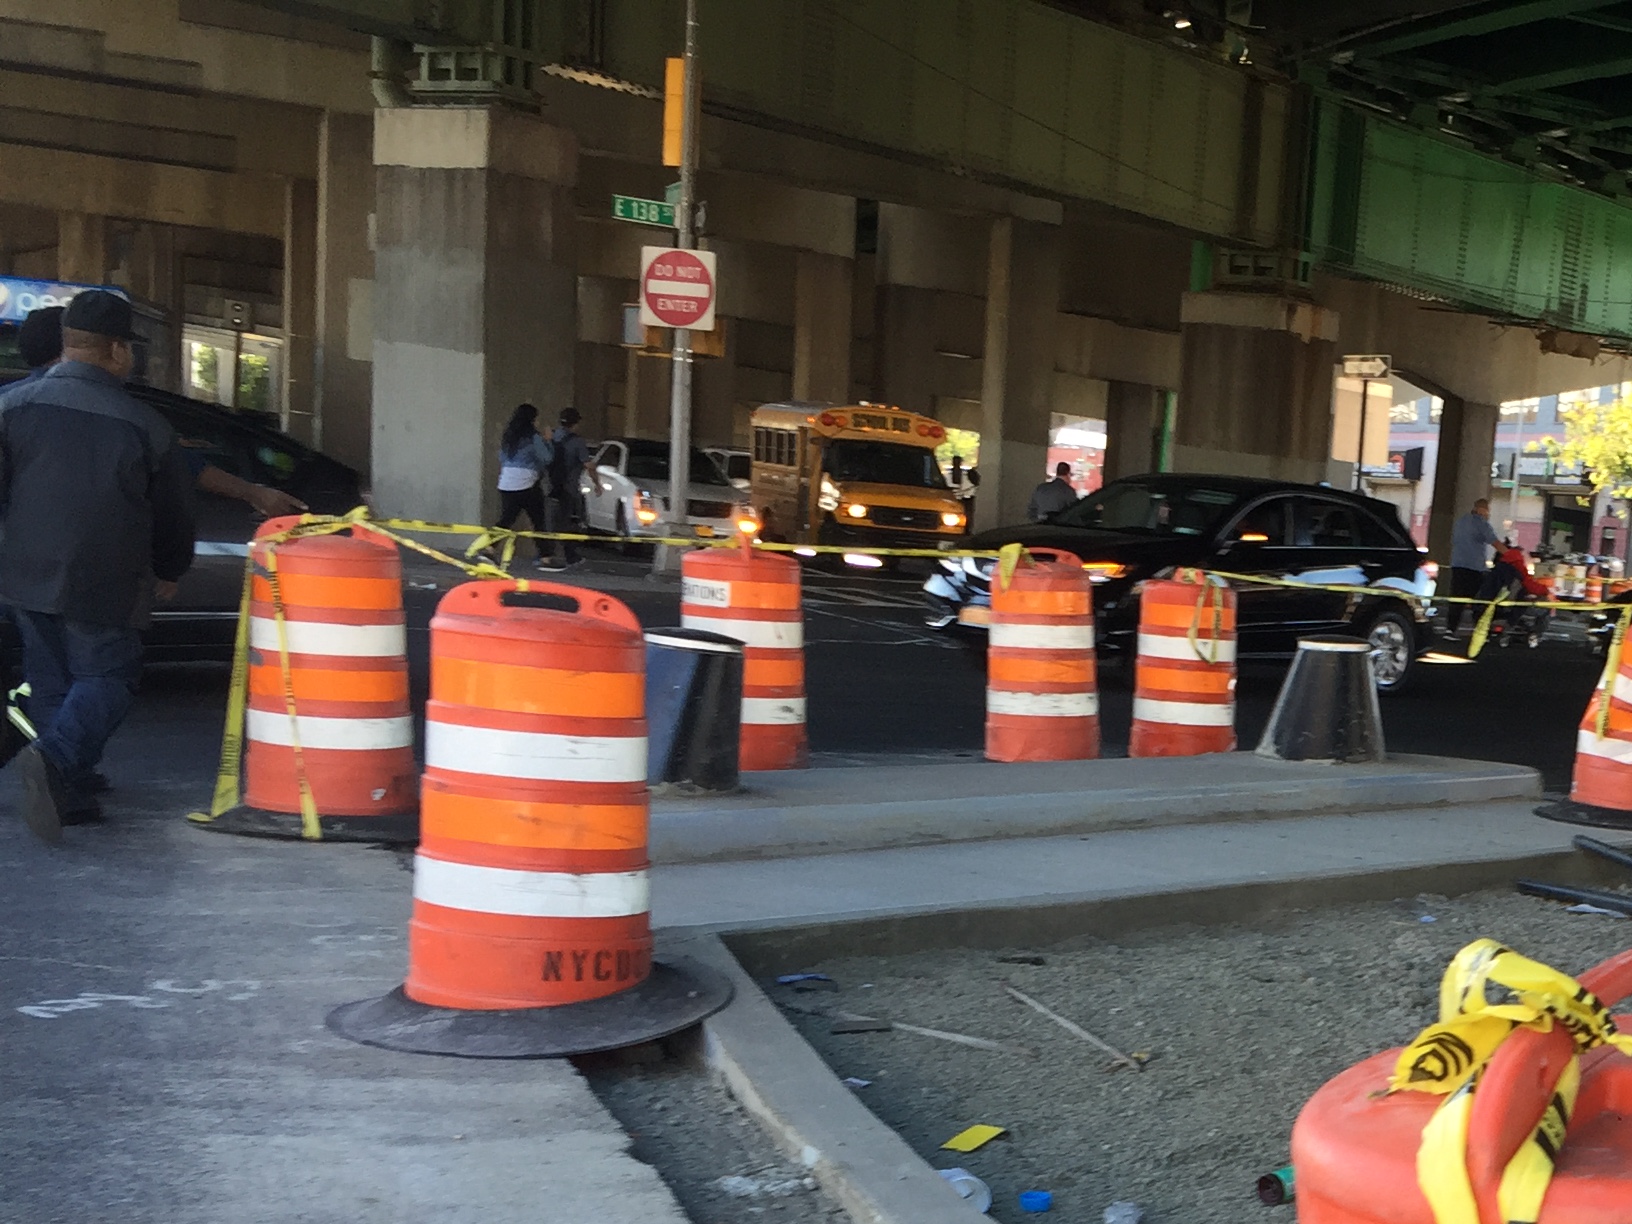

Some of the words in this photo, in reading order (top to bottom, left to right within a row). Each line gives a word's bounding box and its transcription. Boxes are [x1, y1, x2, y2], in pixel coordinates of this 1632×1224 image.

[614, 199, 624, 216] E
[631, 202, 660, 222] 138
[654, 263, 674, 277] DO
[675, 266, 702, 279] NOT
[656, 298, 698, 313] ENTER
